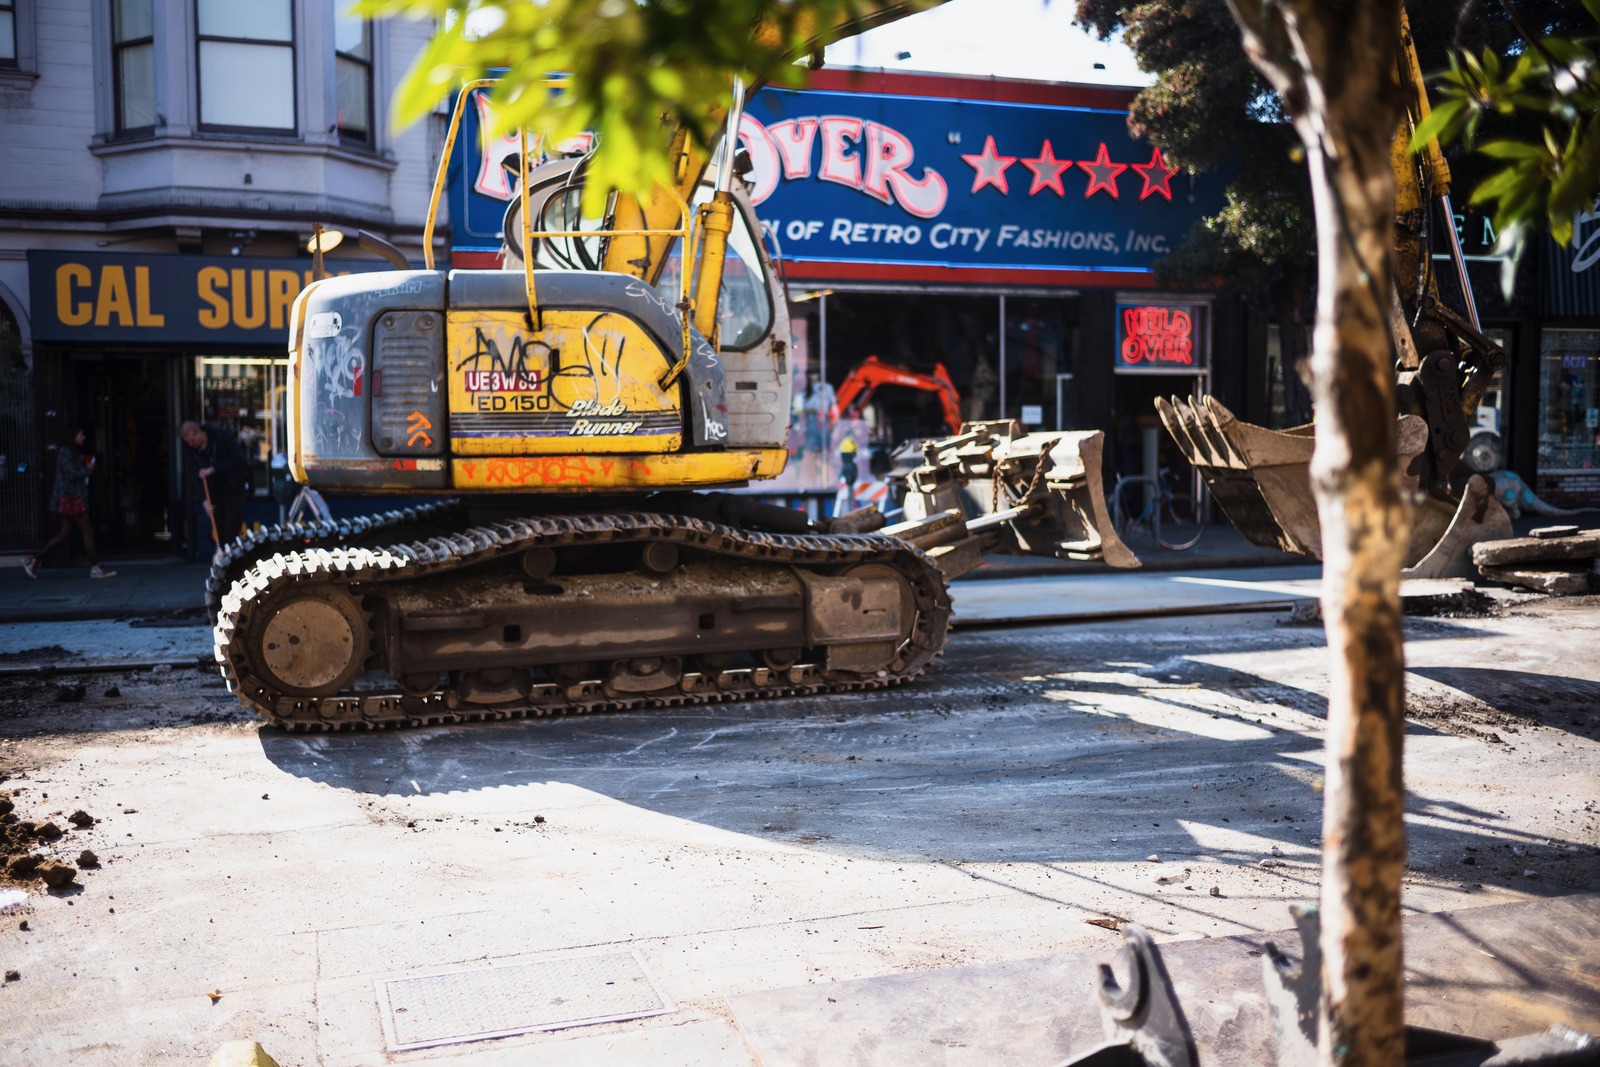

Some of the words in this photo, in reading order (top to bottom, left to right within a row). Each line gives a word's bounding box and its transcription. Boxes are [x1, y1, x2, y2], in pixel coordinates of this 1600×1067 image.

[786, 219, 824, 241] OF
[829, 217, 922, 246] RETRO
[929, 222, 990, 252] CITY
[996, 225, 1121, 255] FASHIONS,
[1125, 229, 1171, 254] INC.
[56, 263, 165, 327] CAL
[197, 266, 352, 330] SUR
[1124, 306, 1192, 337] HELD
[1121, 335, 1193, 365] OVER
[565, 399, 627, 418] Blade
[569, 418, 643, 436] Runner
